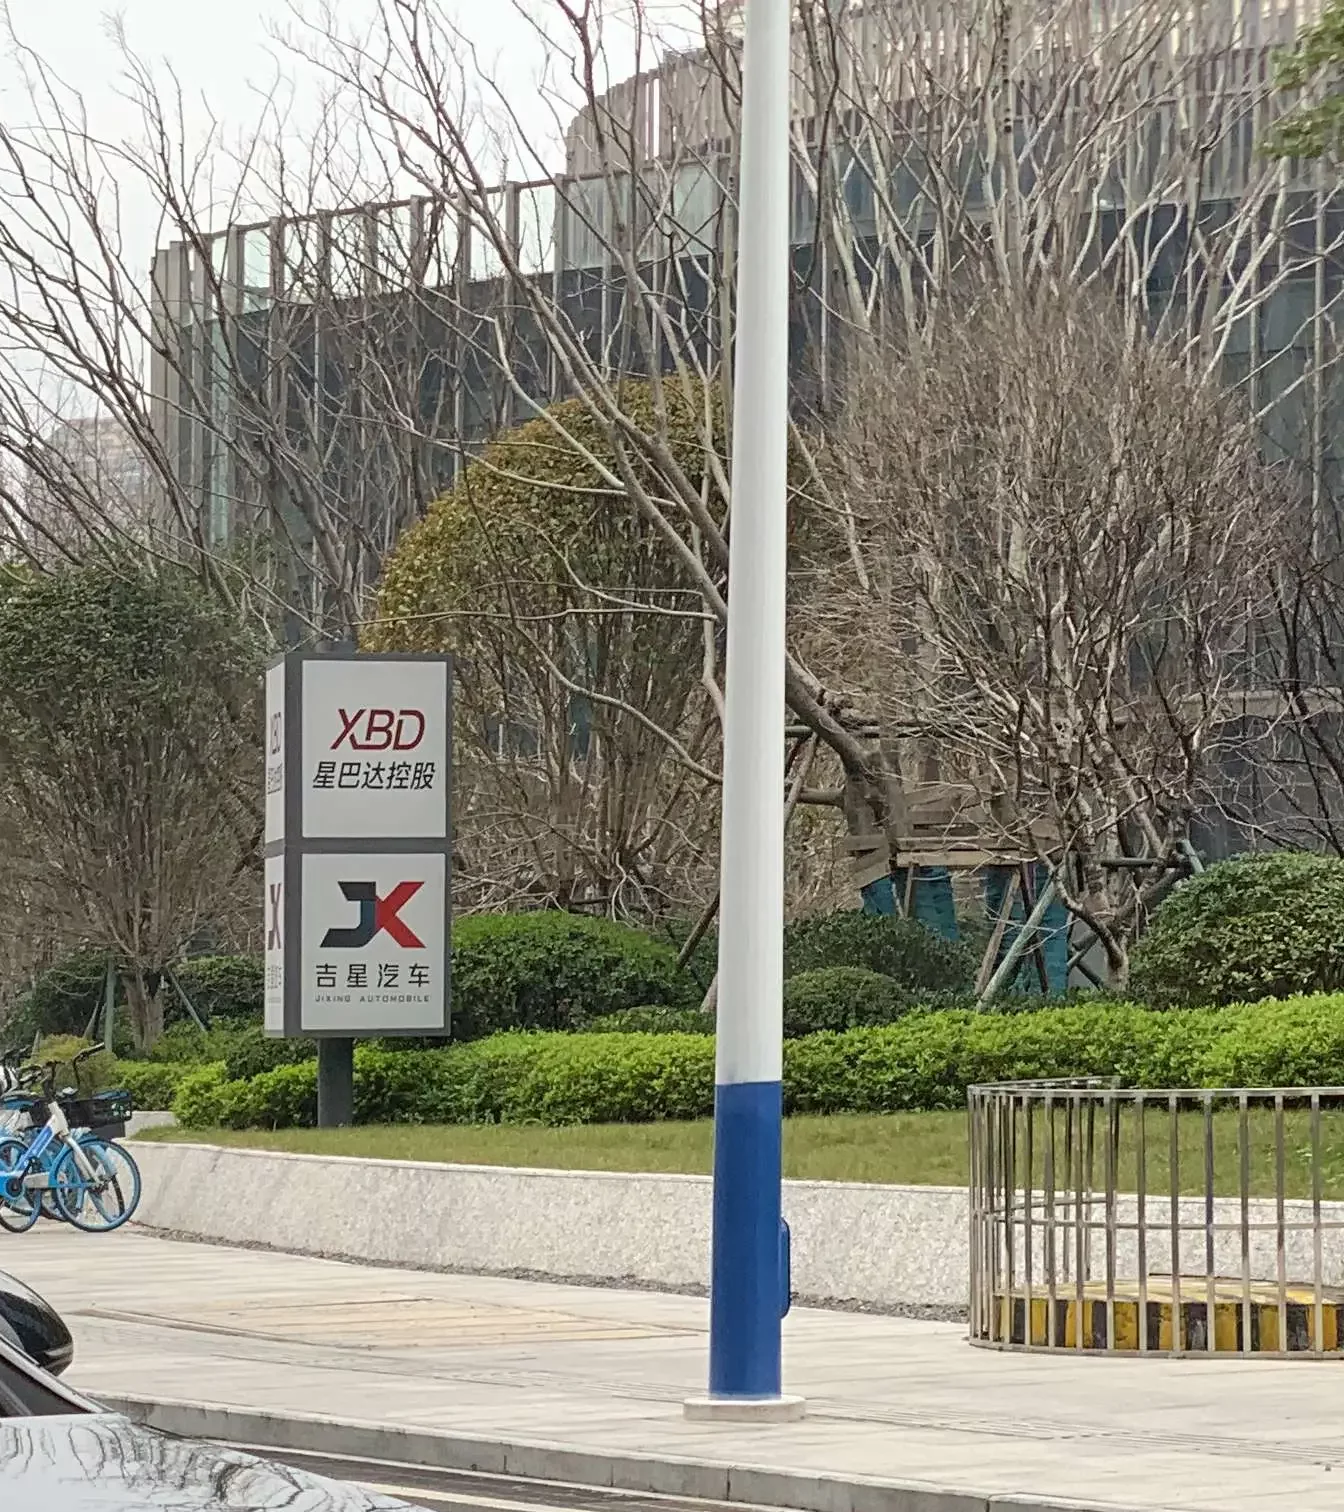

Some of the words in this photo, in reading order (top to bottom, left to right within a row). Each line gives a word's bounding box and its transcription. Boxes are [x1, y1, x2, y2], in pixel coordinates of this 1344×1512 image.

[329, 708, 426, 751] XBD
[312, 761, 436, 790] 星巴达控股
[315, 963, 430, 988] 吉星汽车
[359, 994, 430, 1003] AUTOMOBILE
